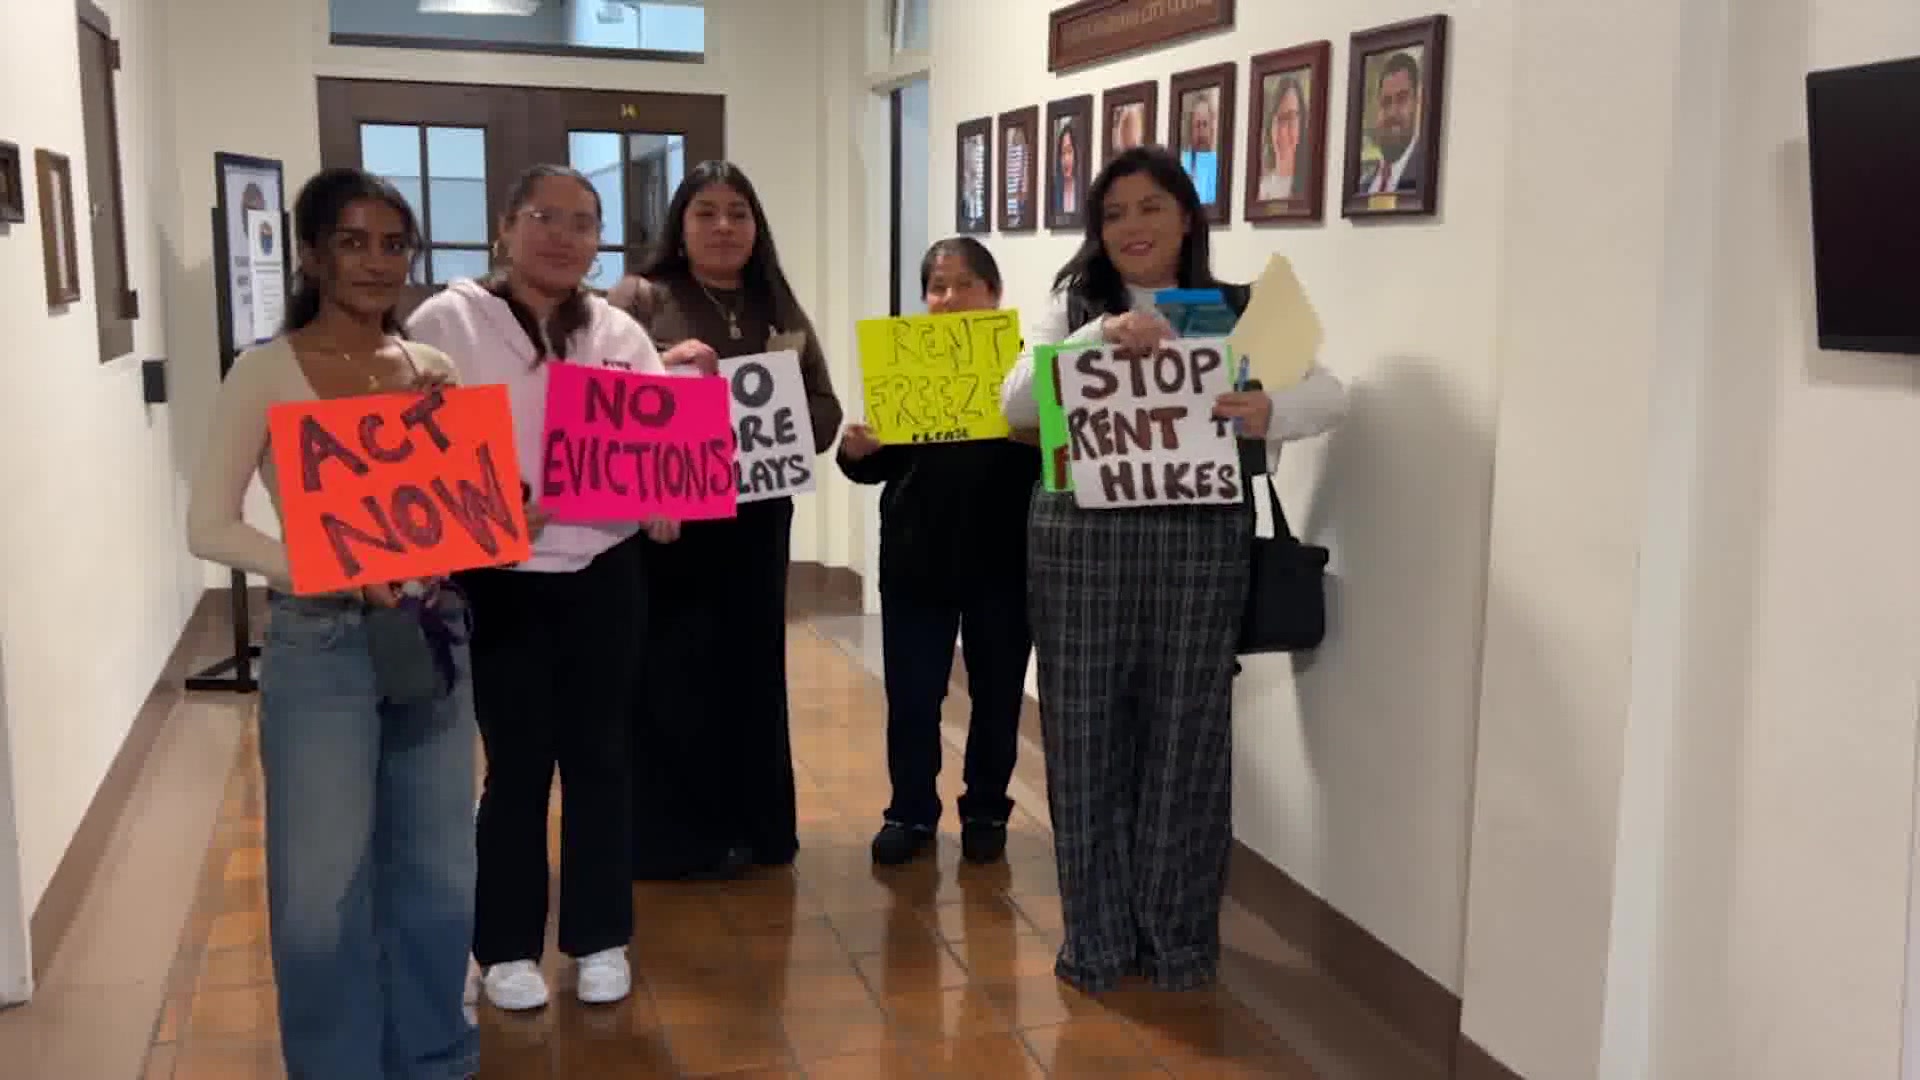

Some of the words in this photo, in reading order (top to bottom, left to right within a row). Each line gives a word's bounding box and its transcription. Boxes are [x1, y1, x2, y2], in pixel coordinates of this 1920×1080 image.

[731, 362, 774, 408] O
[1075, 346, 1221, 399] STOP
[584, 376, 675, 430] NO
[733, 407, 798, 452] RE
[300, 386, 450, 492] ACT
[1068, 407, 1188, 460] RENT
[543, 428, 733, 504] EVICTIONS
[733, 454, 810, 494] LAYS
[1099, 461, 1238, 501] HIKES
[320, 441, 519, 579] NOW
